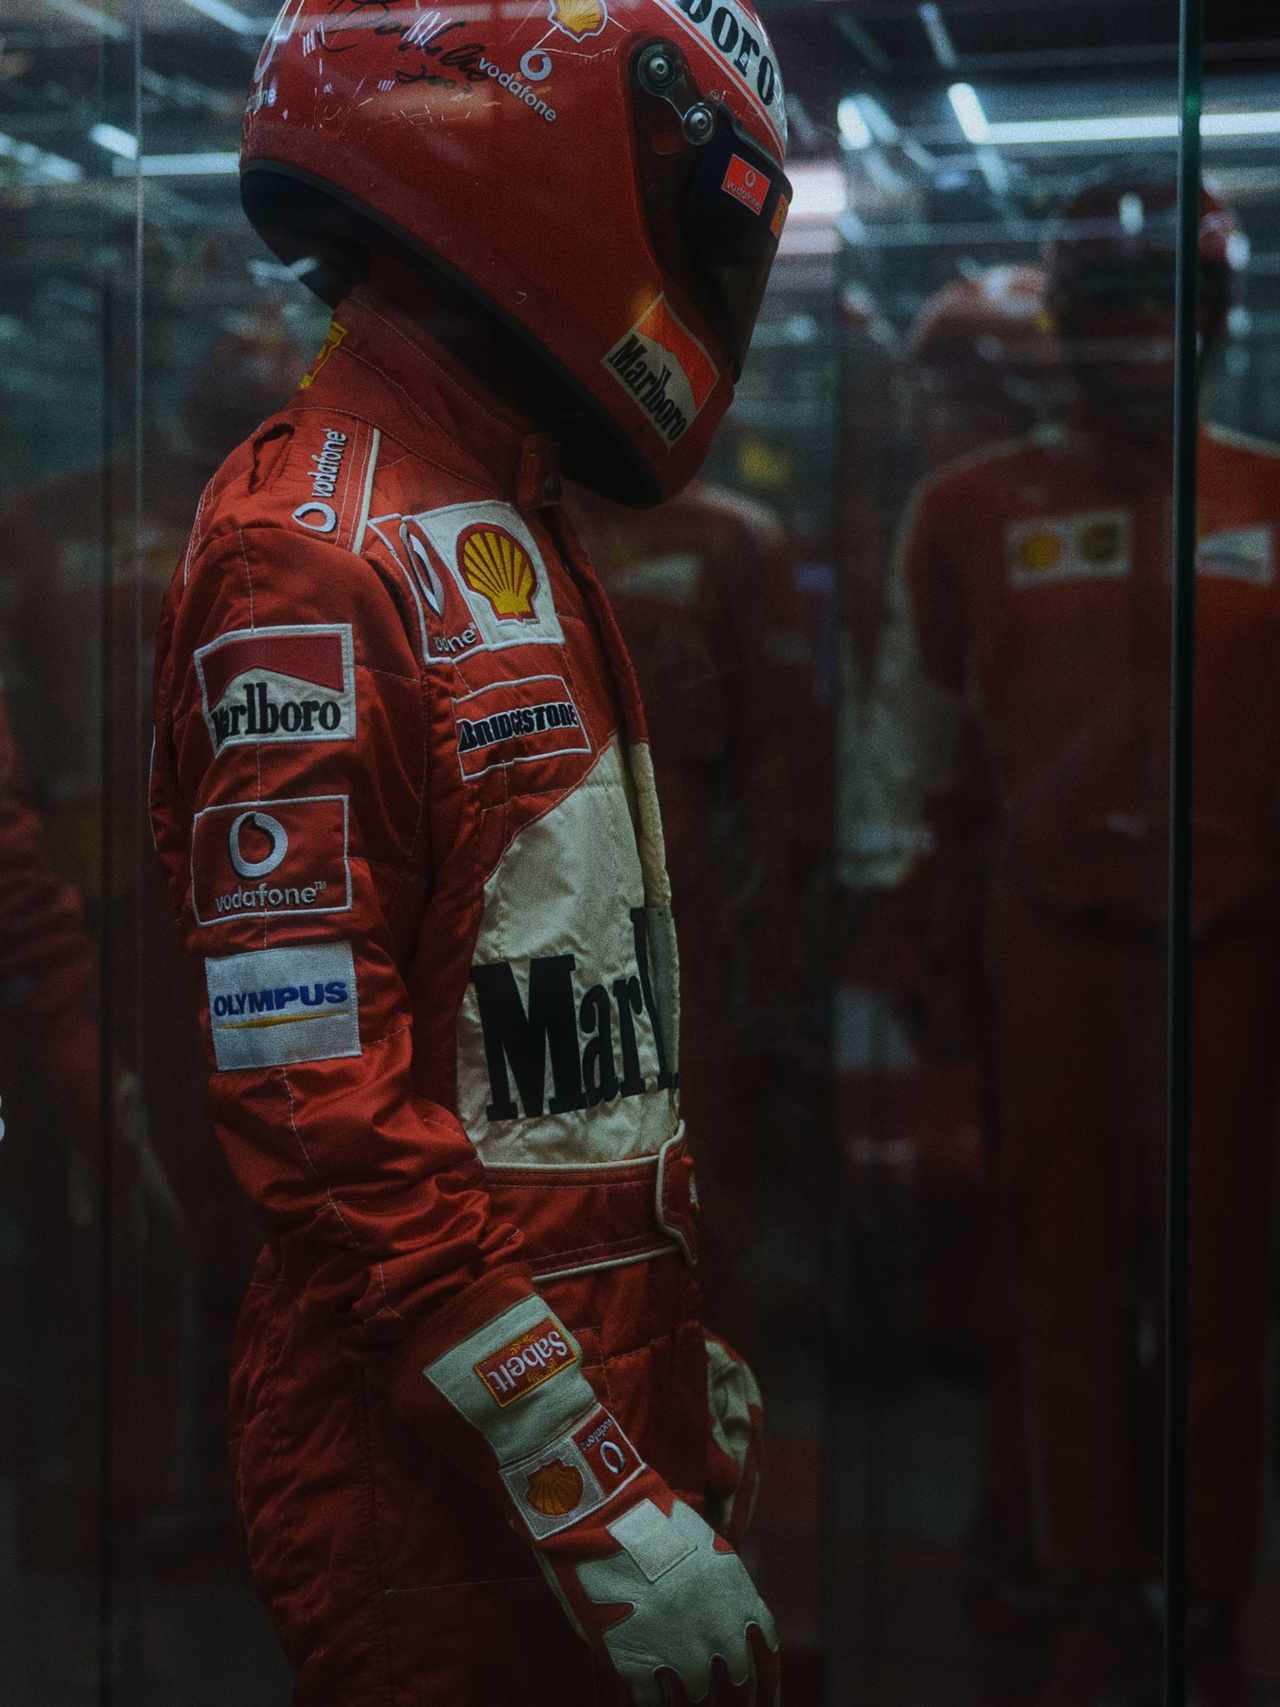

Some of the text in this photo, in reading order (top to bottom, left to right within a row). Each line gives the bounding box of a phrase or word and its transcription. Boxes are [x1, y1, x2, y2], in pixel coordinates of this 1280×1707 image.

[478, 56, 558, 122] vodafone
[726, 180, 761, 210] vodafone
[607, 333, 688, 441] Marlboro
[213, 981, 348, 1016] OLYMPUS
[486, 1330, 568, 1393] Sabelt
